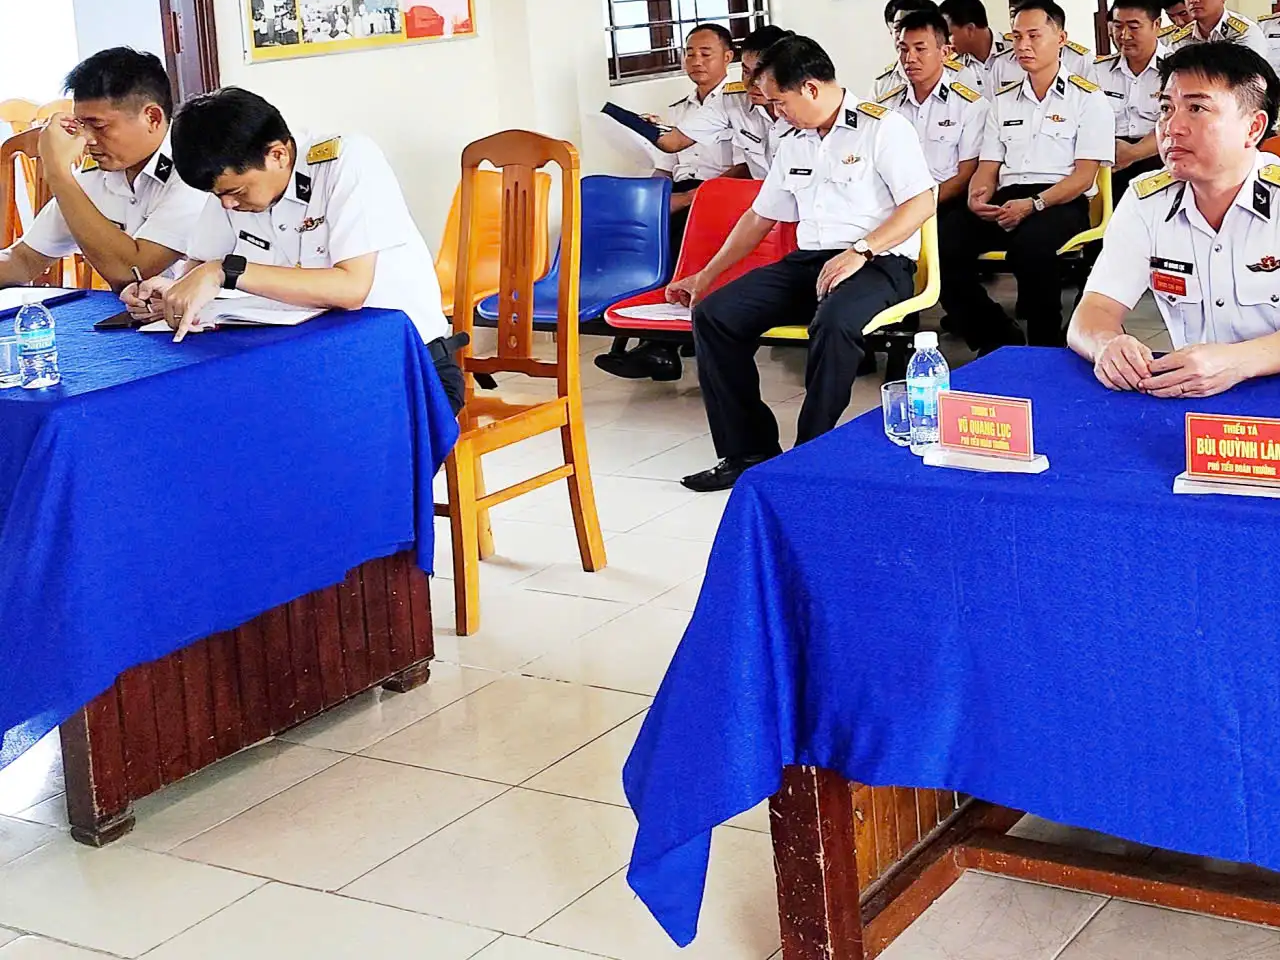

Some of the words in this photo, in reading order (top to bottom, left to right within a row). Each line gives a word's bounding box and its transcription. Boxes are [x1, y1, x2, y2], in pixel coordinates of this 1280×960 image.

[958, 415, 968, 433] VŨ
[969, 419, 996, 437] QUANG
[996, 422, 1012, 440] LỤC
[1223, 423, 1246, 435] THIẾU
[1247, 424, 1258, 435] TÁ
[1196, 435, 1216, 456] BÙI
[1218, 437, 1258, 459] QUỲNH
[1207, 461, 1220, 471] PHÓ
[1220, 460, 1234, 473] TIỂU
[1234, 463, 1251, 474] ĐOÀN
[1252, 464, 1276, 476] TRƯỞNG
